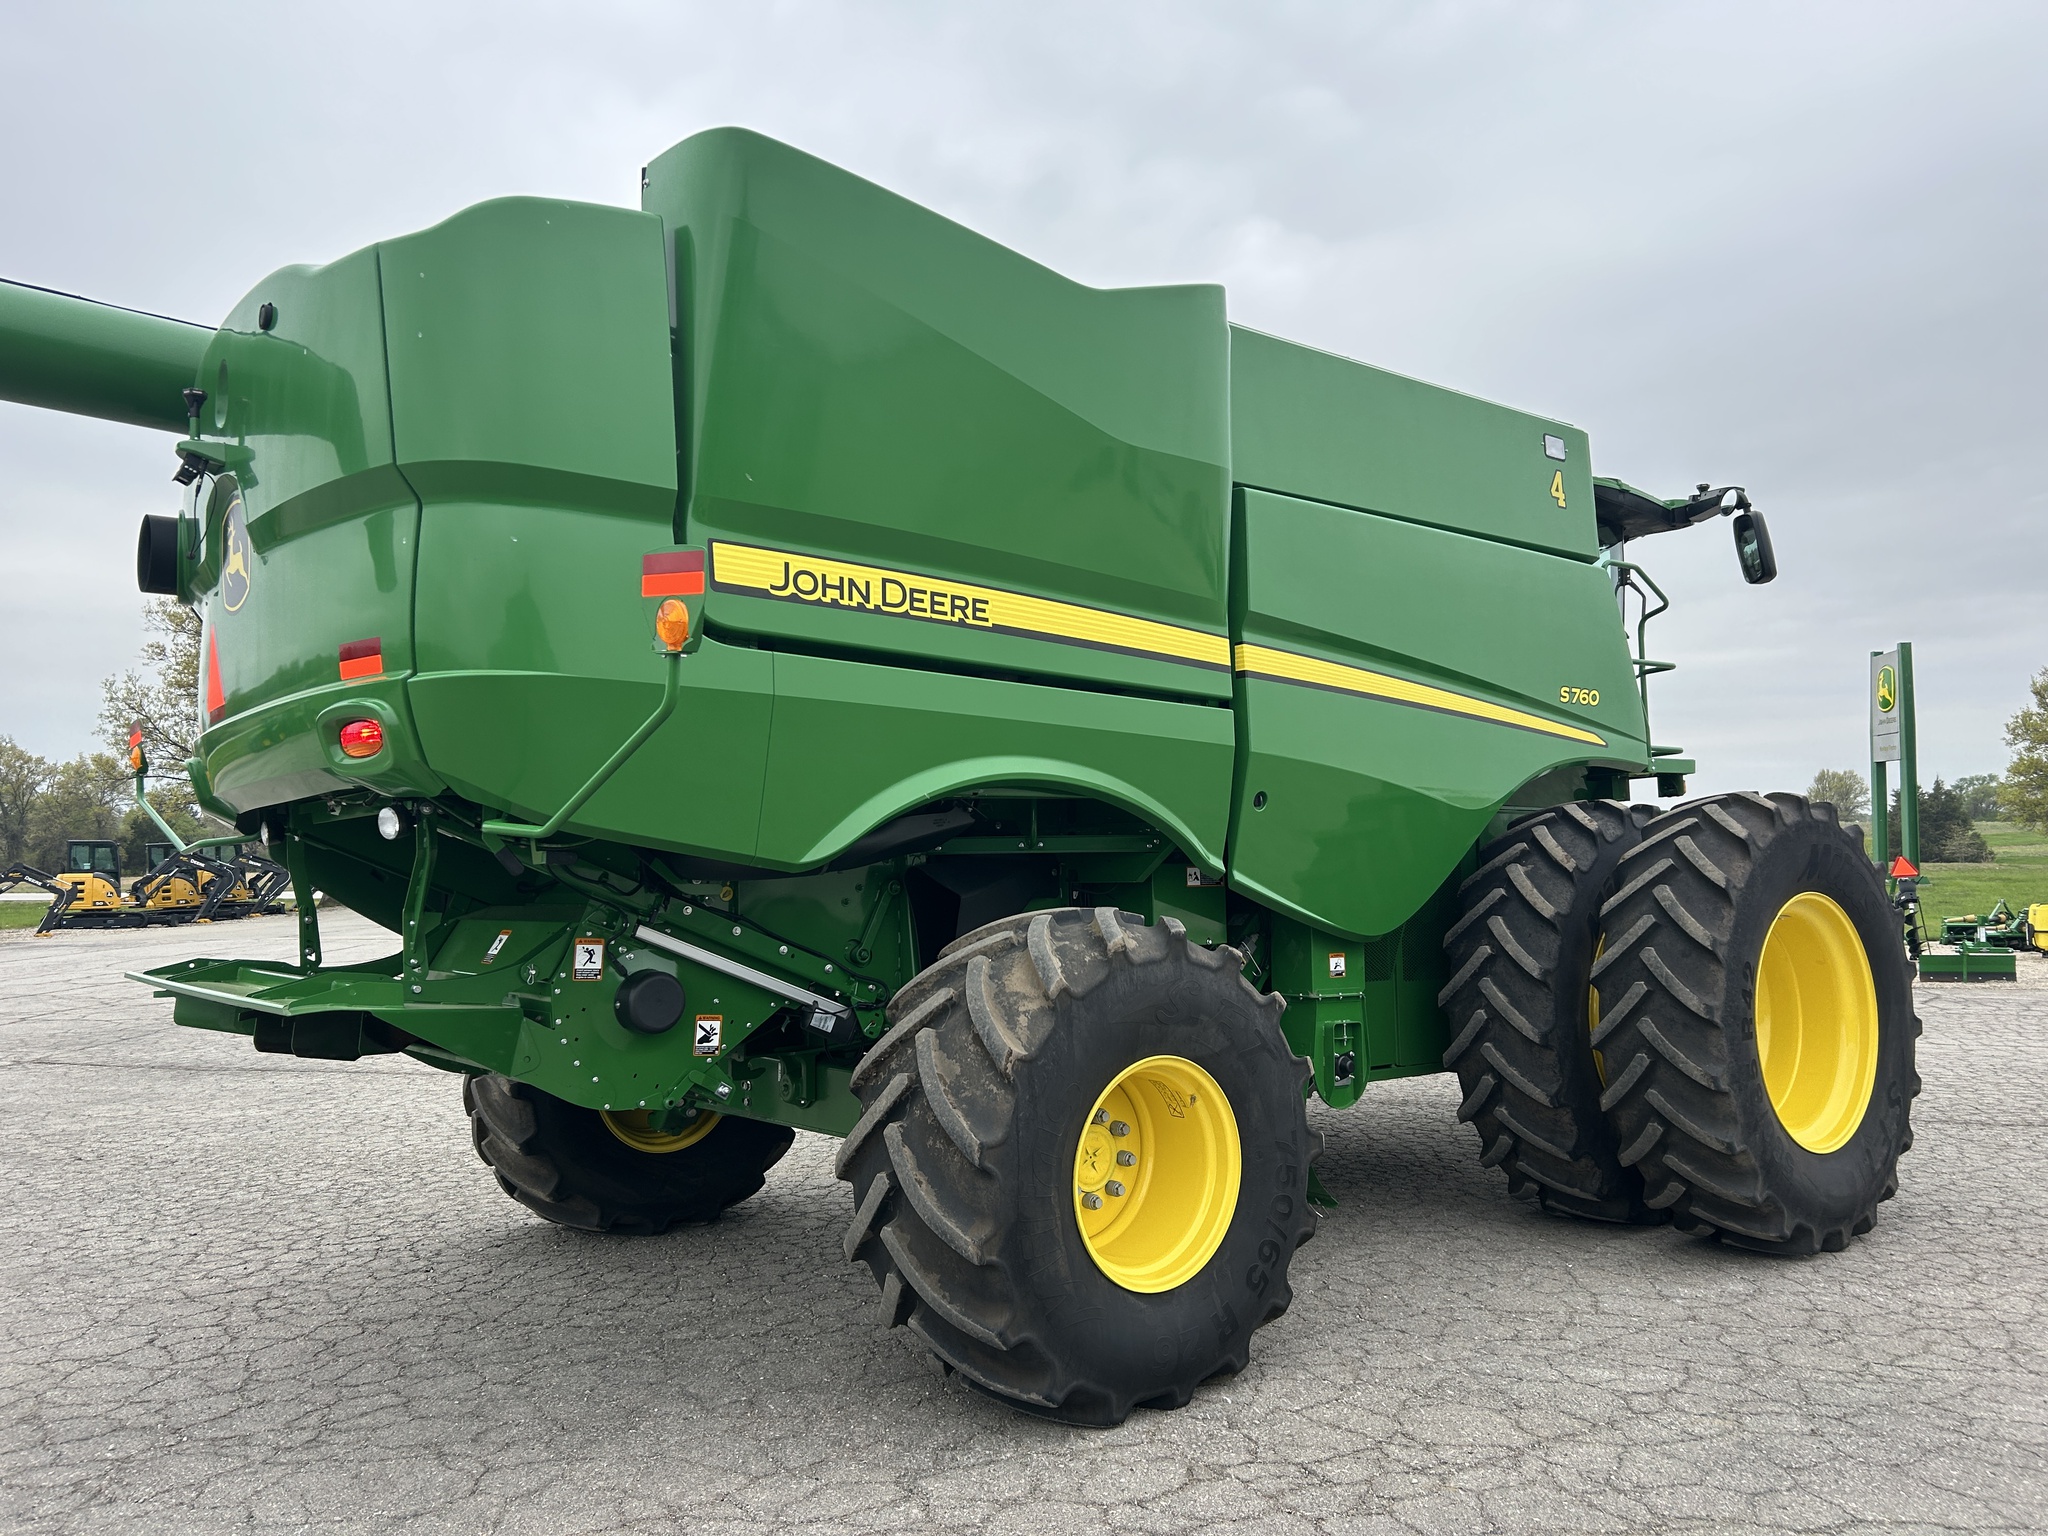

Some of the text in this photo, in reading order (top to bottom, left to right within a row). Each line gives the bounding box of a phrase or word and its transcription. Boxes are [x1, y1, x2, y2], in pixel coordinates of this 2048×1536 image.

[1550, 470, 1567, 509] 4
[769, 561, 990, 623] JOHN DEERE
[24, 875, 43, 887] DEERE
[190, 858, 206, 868] DEERE
[1246, 1129, 1298, 1300] 750/65
